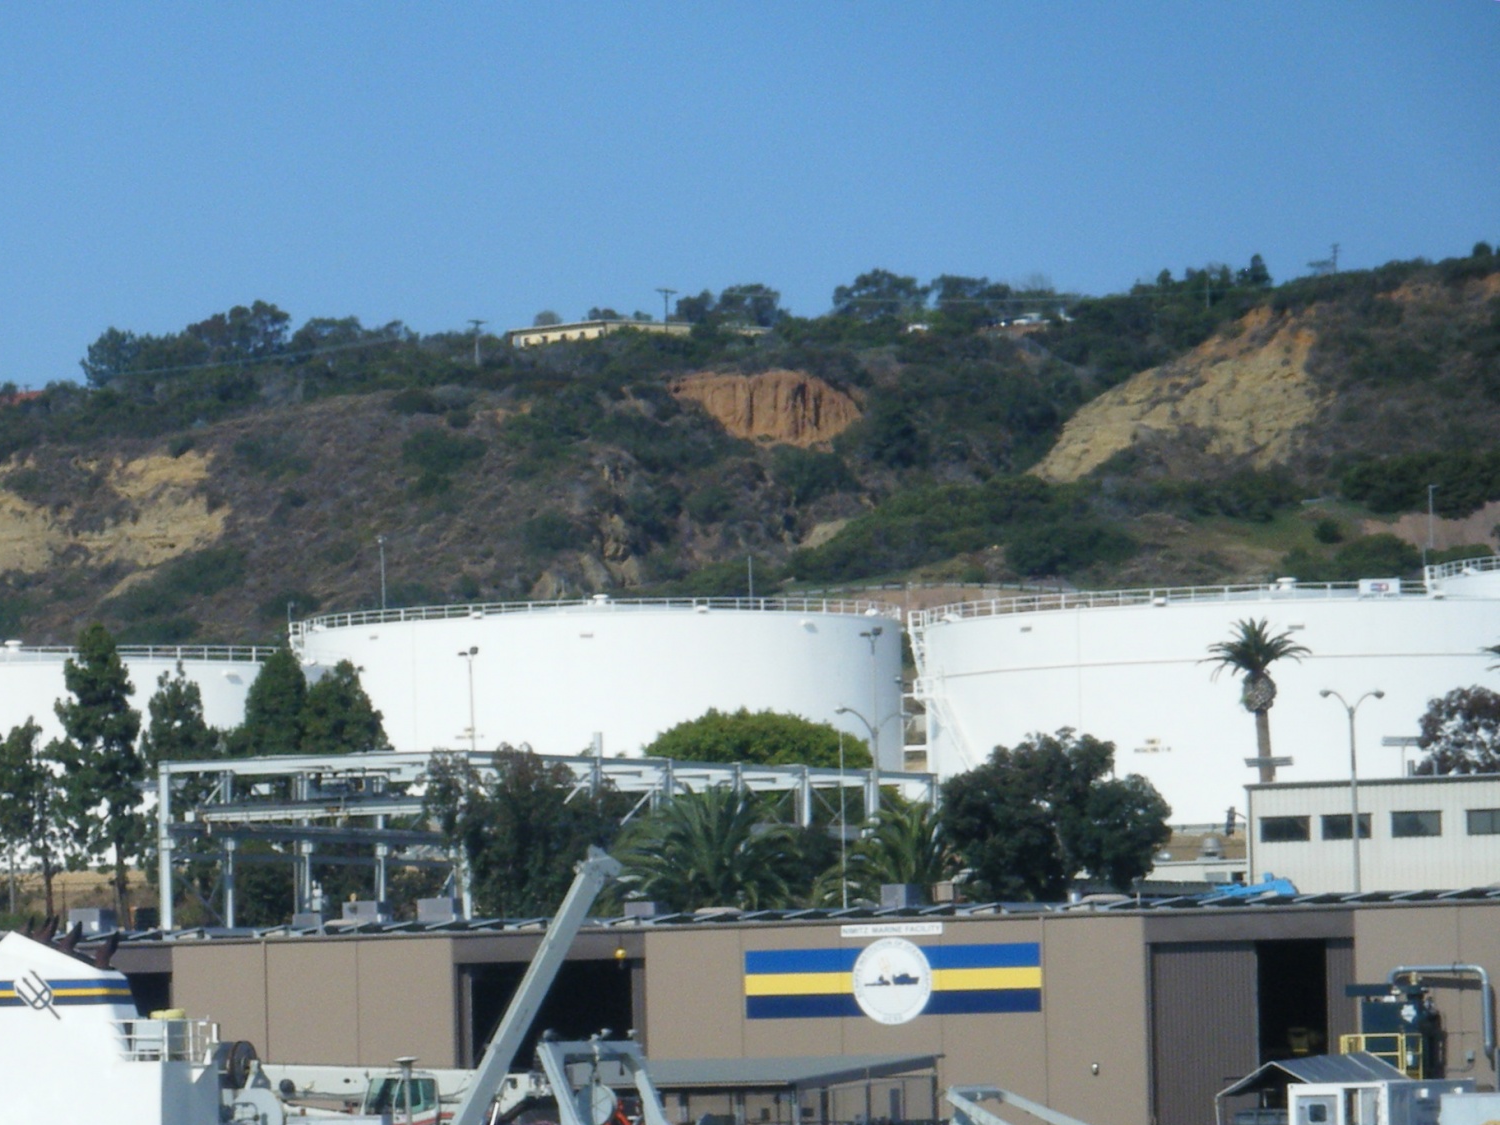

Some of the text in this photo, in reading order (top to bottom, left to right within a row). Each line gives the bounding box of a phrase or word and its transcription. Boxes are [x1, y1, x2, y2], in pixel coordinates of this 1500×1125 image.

[842, 924, 940, 935] NIMITZ MARINE FACILITY
